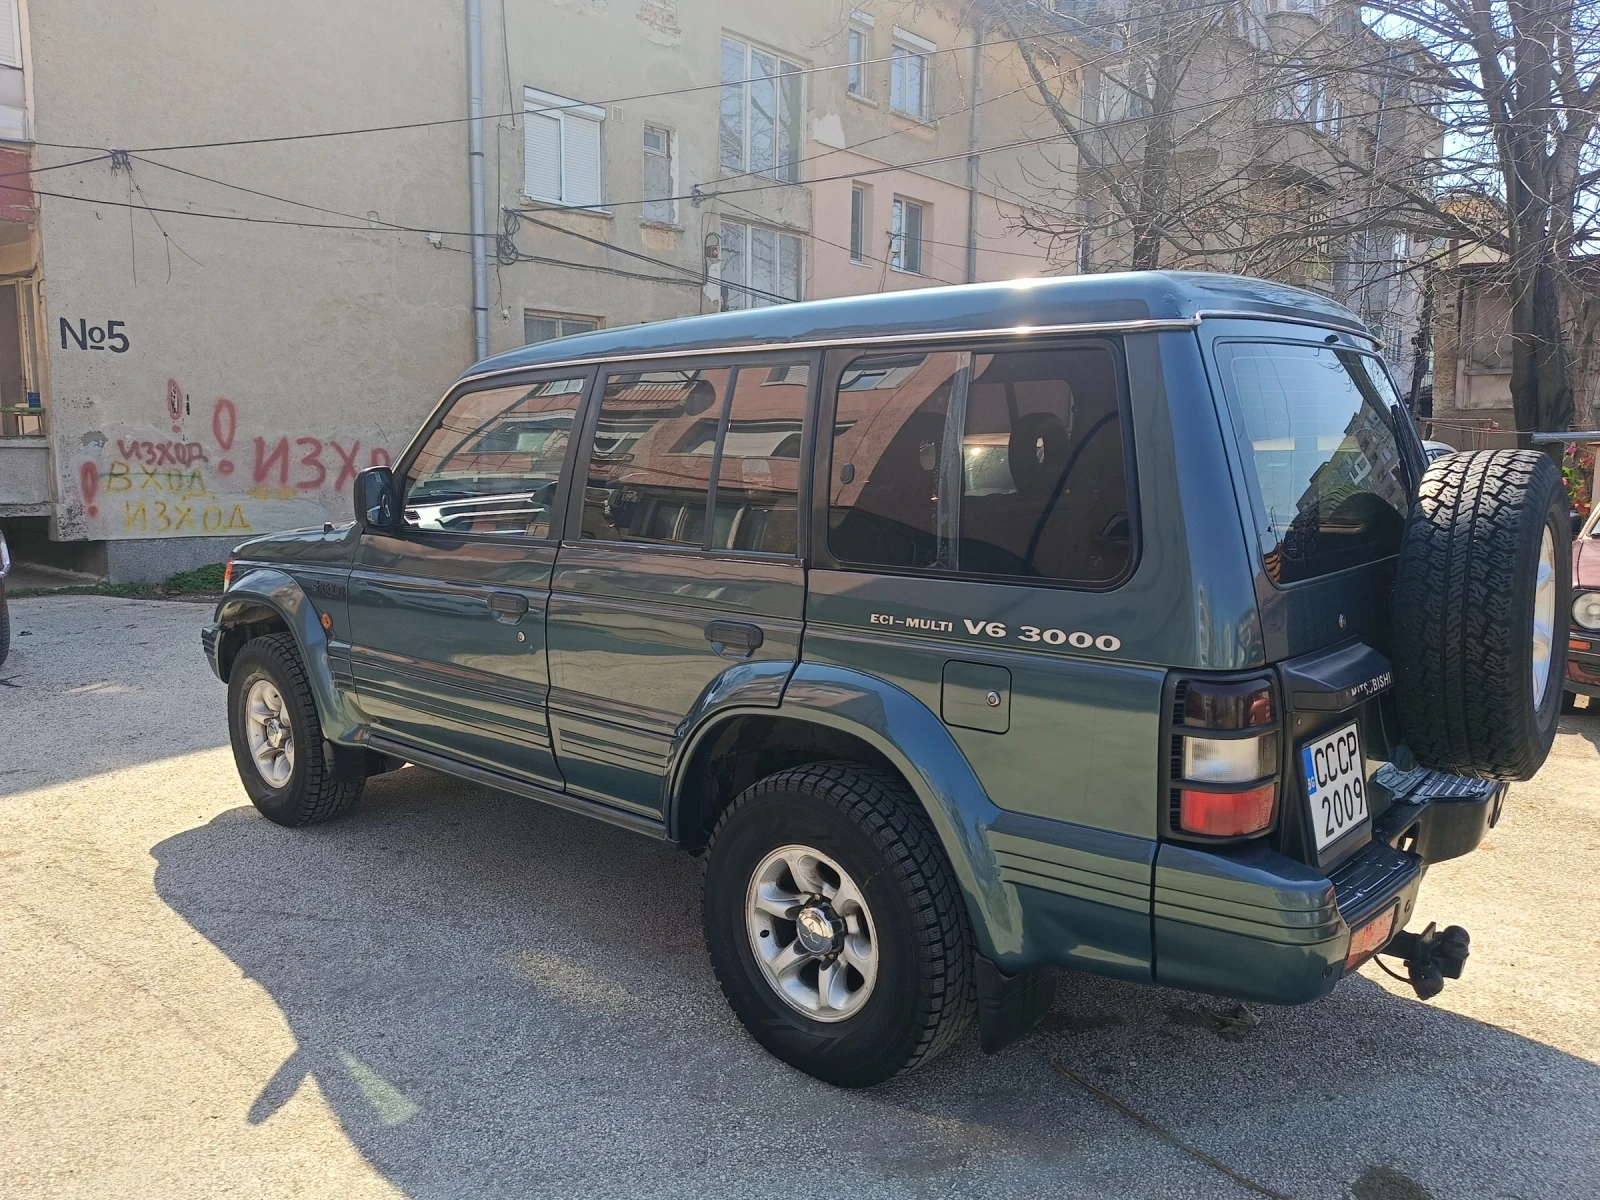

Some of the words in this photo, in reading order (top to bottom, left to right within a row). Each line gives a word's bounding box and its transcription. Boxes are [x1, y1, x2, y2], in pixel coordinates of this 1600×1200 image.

[106, 460, 215, 500] ВХОД
[124, 500, 253, 532] ИЗХОД
[870, 613, 953, 632] ECI-MULTI
[963, 619, 1007, 638] V6
[1017, 625, 1121, 651] 3000
[1321, 777, 1363, 838] 2009
